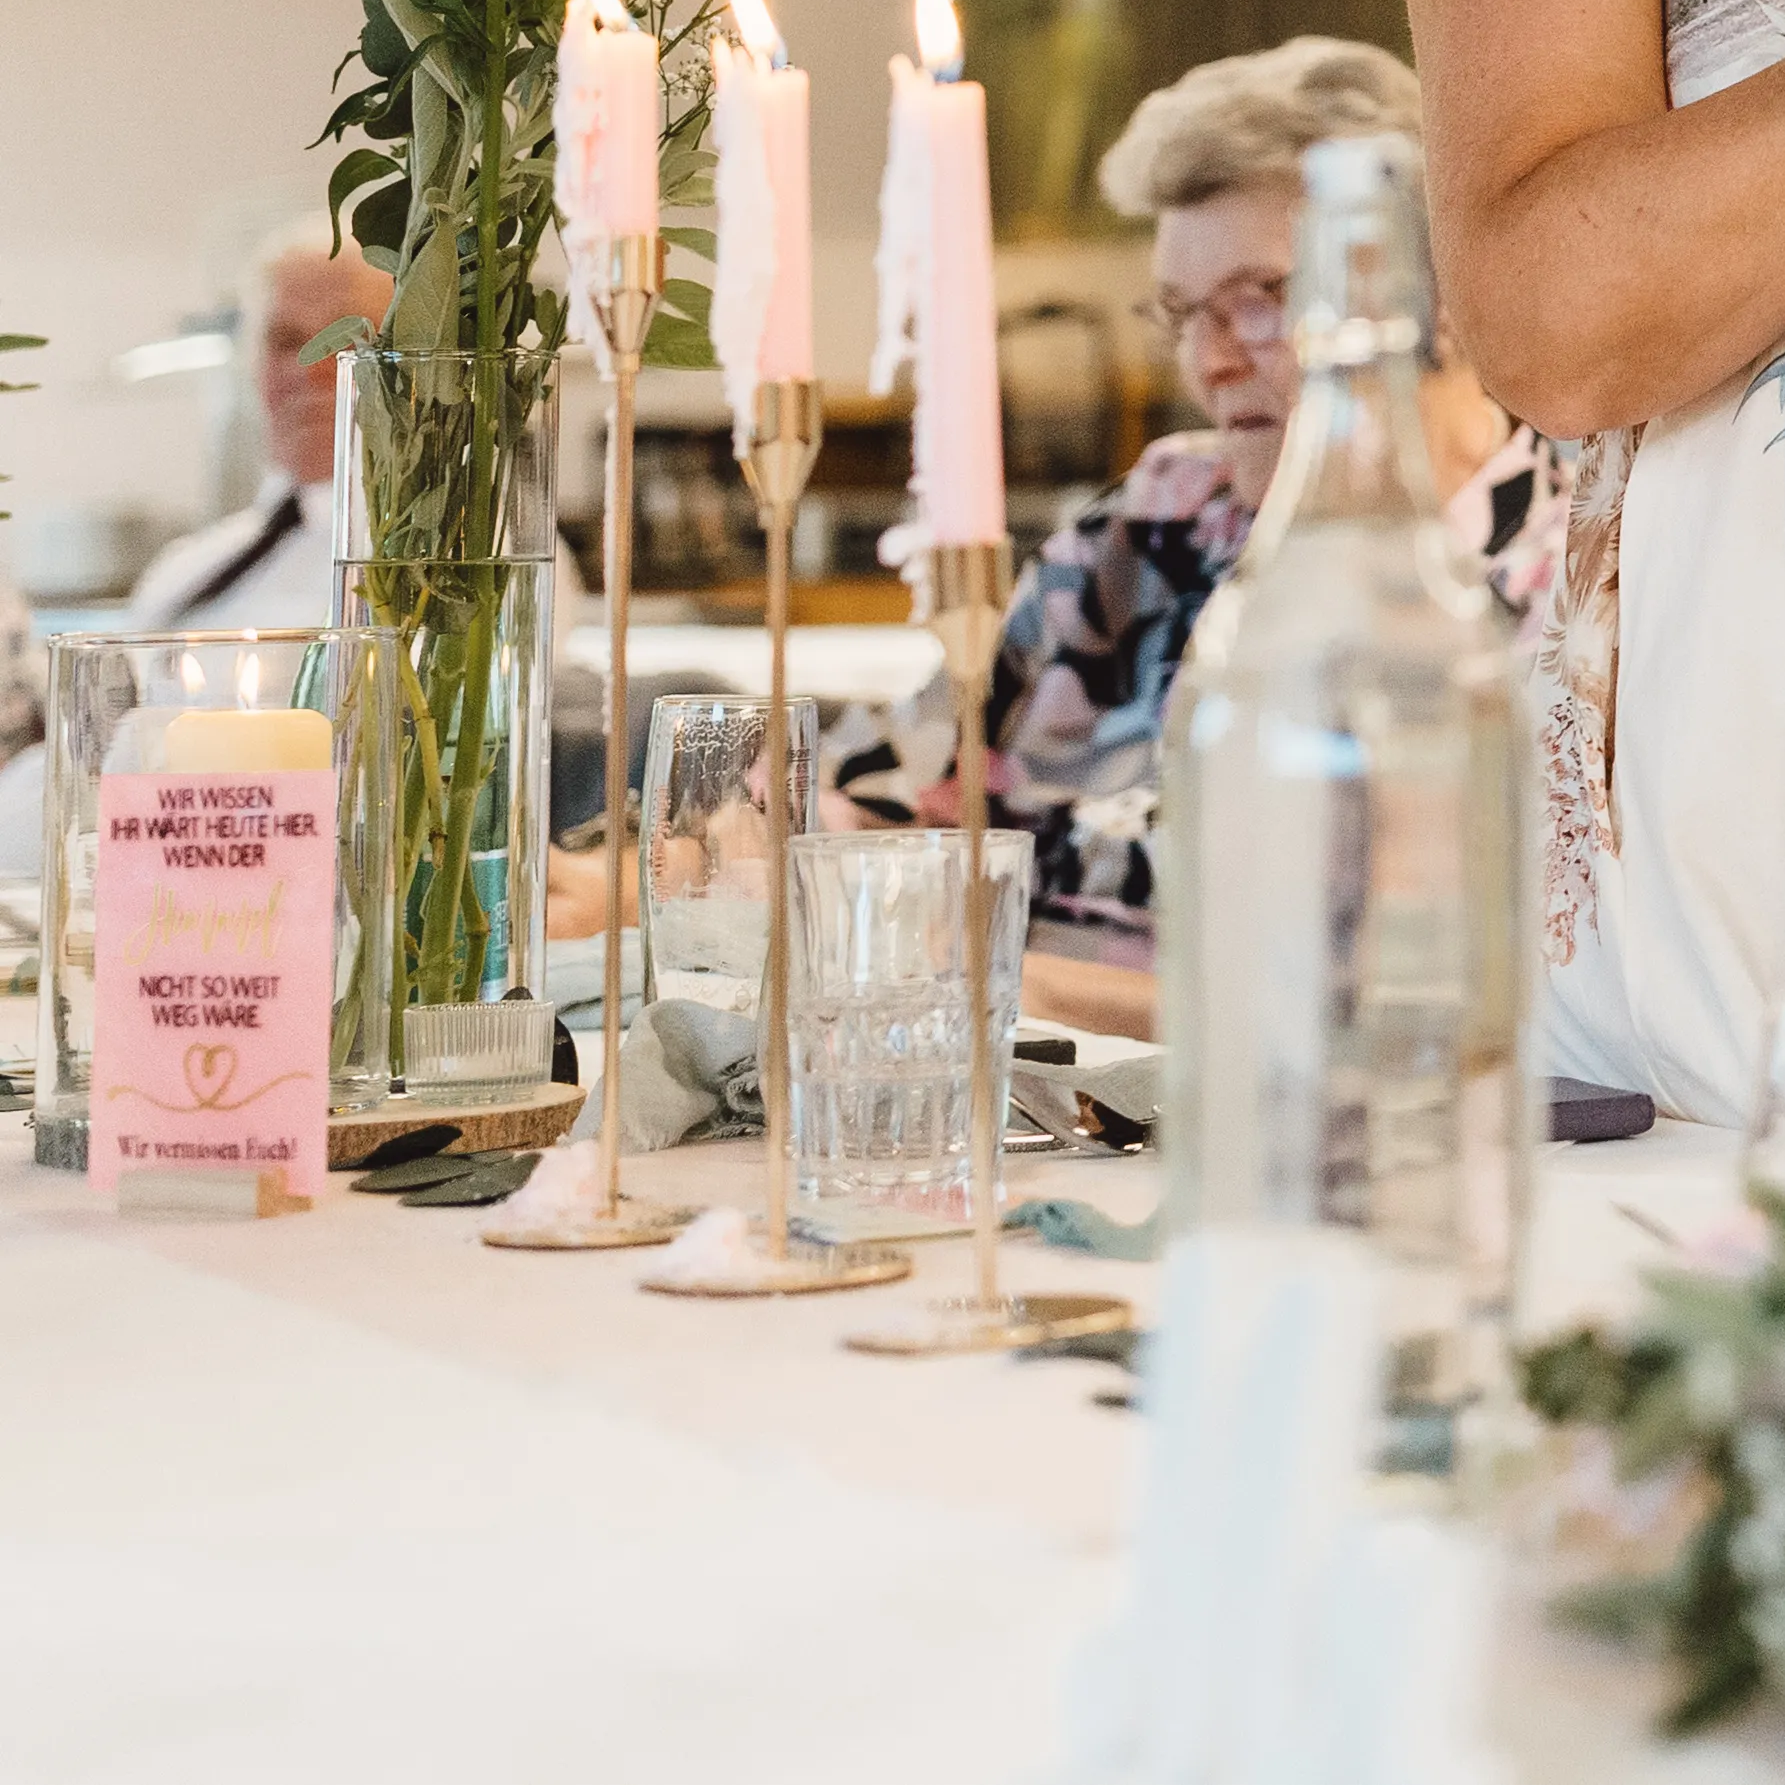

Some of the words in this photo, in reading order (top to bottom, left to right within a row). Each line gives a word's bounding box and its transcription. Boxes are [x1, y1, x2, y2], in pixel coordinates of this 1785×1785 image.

[157, 787, 195, 810] WIR
[199, 785, 274, 809] WISSEN
[110, 817, 140, 840] IHR
[205, 815, 269, 838] HEUTE
[162, 845, 226, 867] WENN
[228, 844, 266, 866] DER
[138, 975, 198, 999] NICHT
[201, 974, 228, 999] SO
[230, 975, 281, 999] WEIT
[151, 1003, 199, 1028] WEG
[117, 1134, 149, 1159] Wir
[154, 1141, 241, 1160] vermissen
